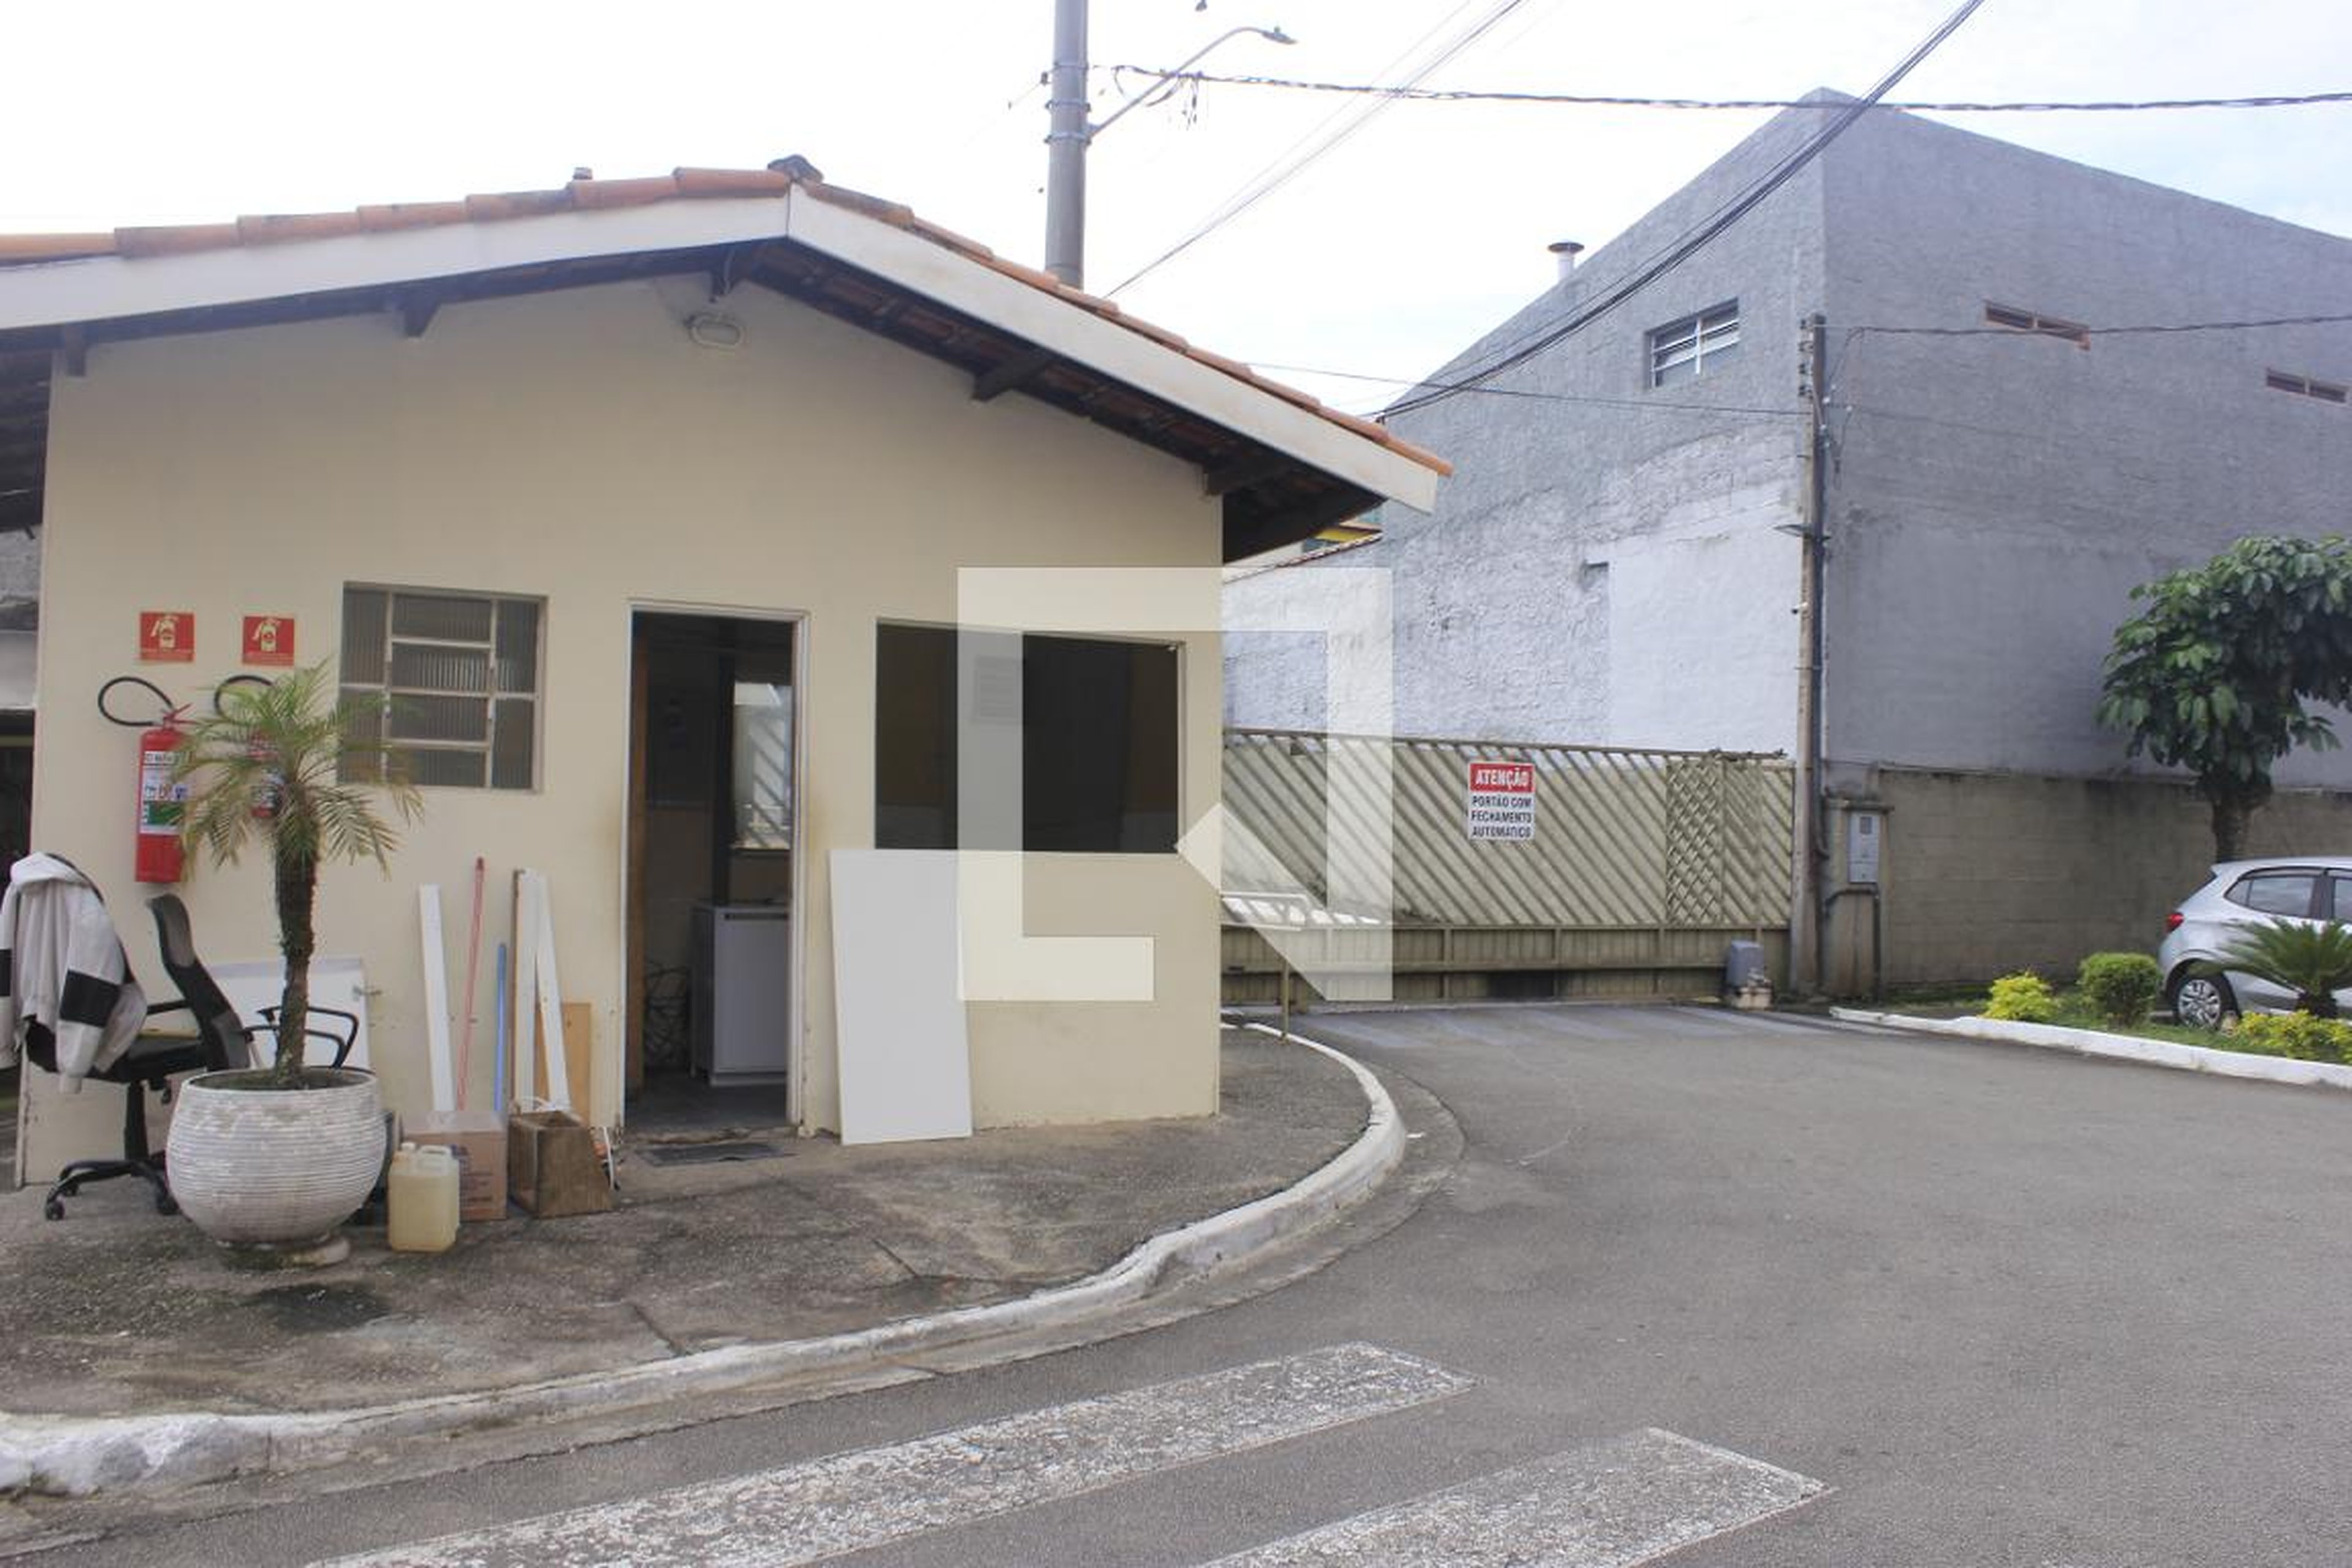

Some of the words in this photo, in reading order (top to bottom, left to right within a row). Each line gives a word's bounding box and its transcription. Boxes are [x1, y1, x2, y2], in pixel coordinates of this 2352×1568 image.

[1476, 767, 1529, 790] ATENÇÃO
[1472, 794, 1509, 807] PORTÃO
[1510, 797, 1532, 808] COM
[1471, 810, 1531, 823] FECHAMENTO
